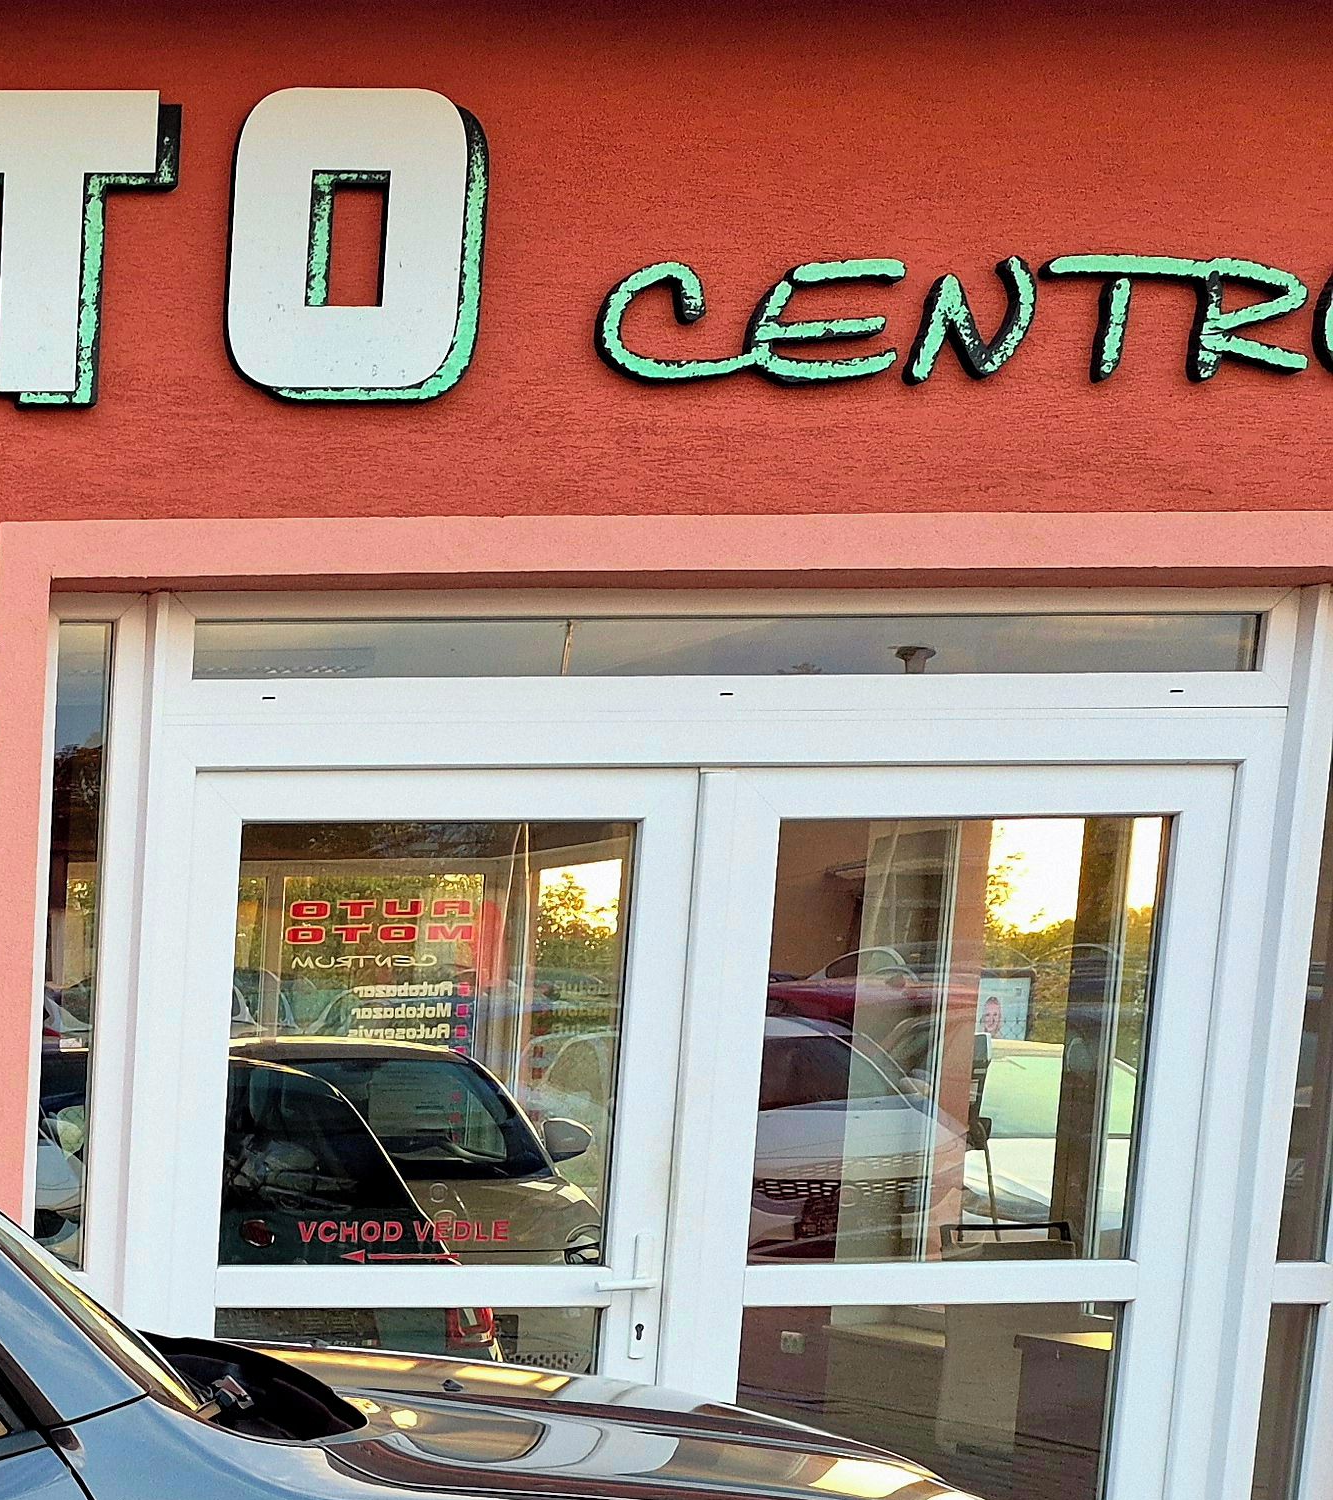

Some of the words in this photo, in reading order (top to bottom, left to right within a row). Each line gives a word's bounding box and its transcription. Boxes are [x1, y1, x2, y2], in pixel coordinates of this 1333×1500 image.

[594, 254, 1333, 387] CENTR
[298, 1220, 403, 1243] VCHOD
[413, 1220, 510, 1243] VEDLE
